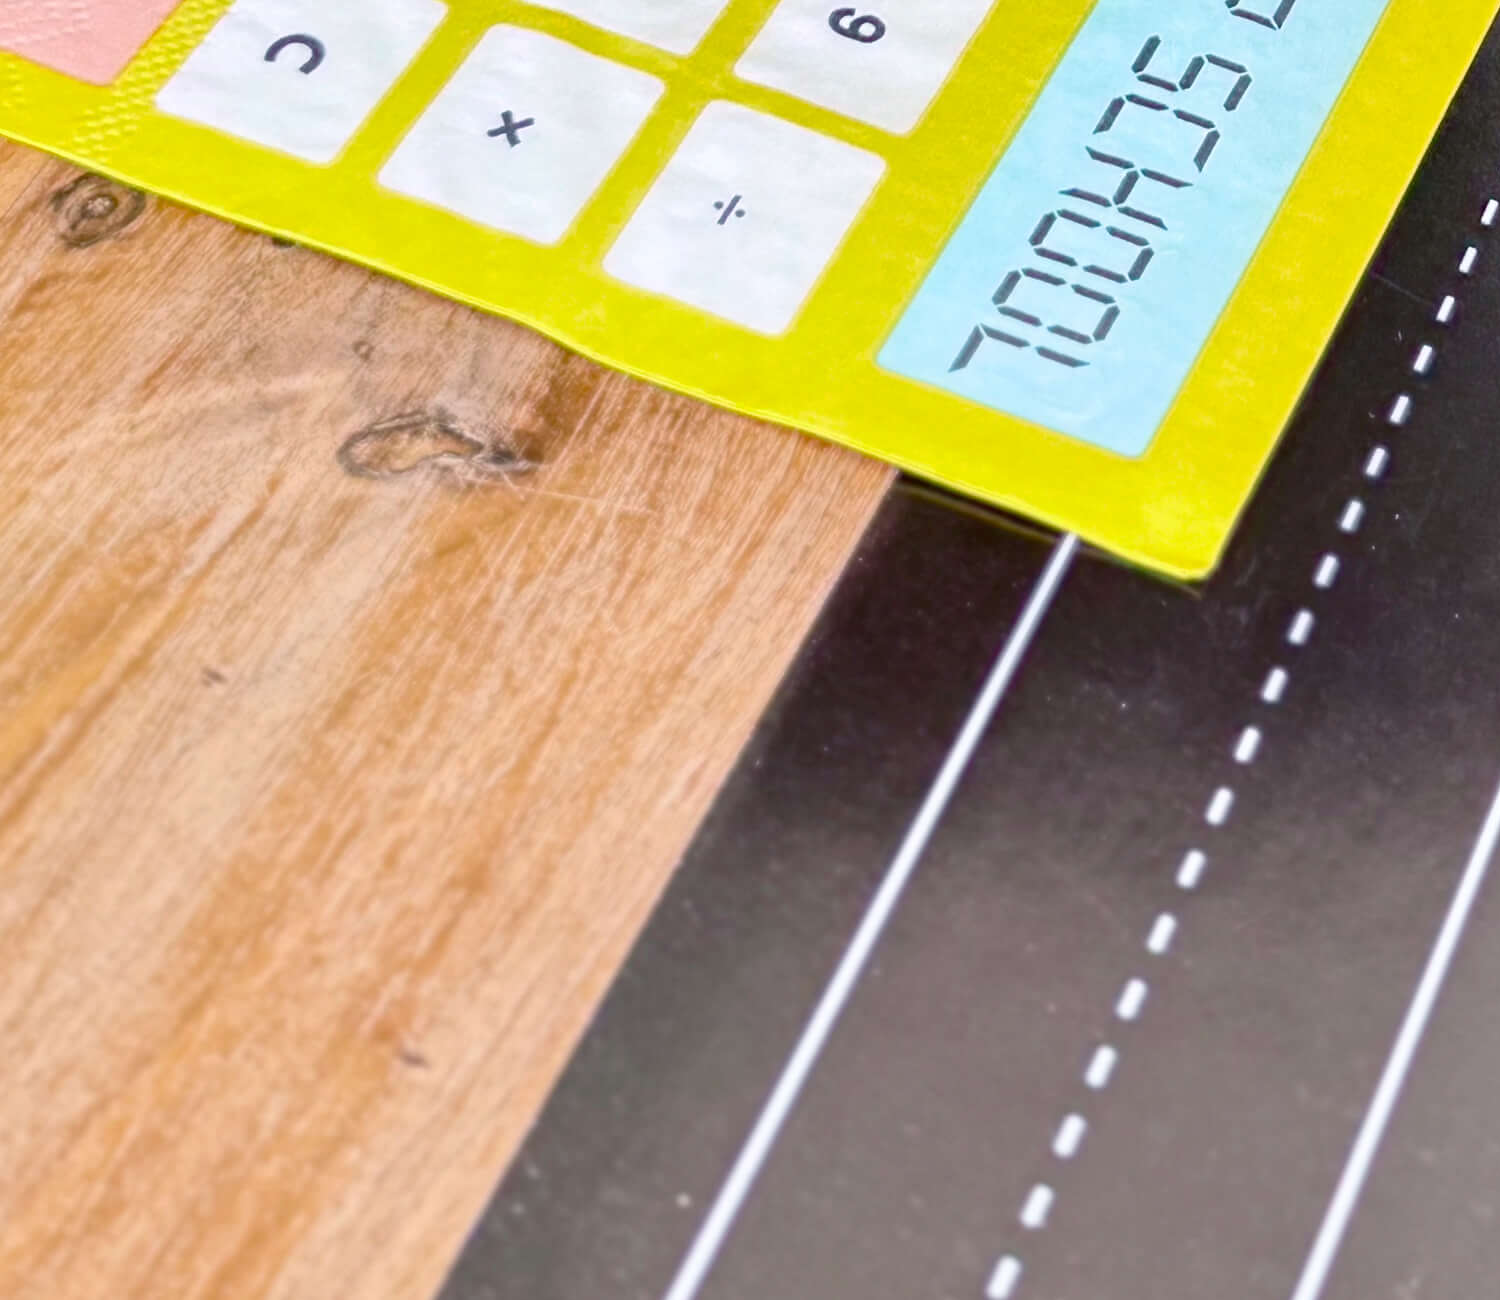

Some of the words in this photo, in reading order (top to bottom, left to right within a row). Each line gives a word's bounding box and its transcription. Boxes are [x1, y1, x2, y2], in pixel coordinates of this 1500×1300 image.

[827, 6, 888, 44] 9
[264, 32, 326, 76] C
[947, 34, 1254, 374] SCHOOL
